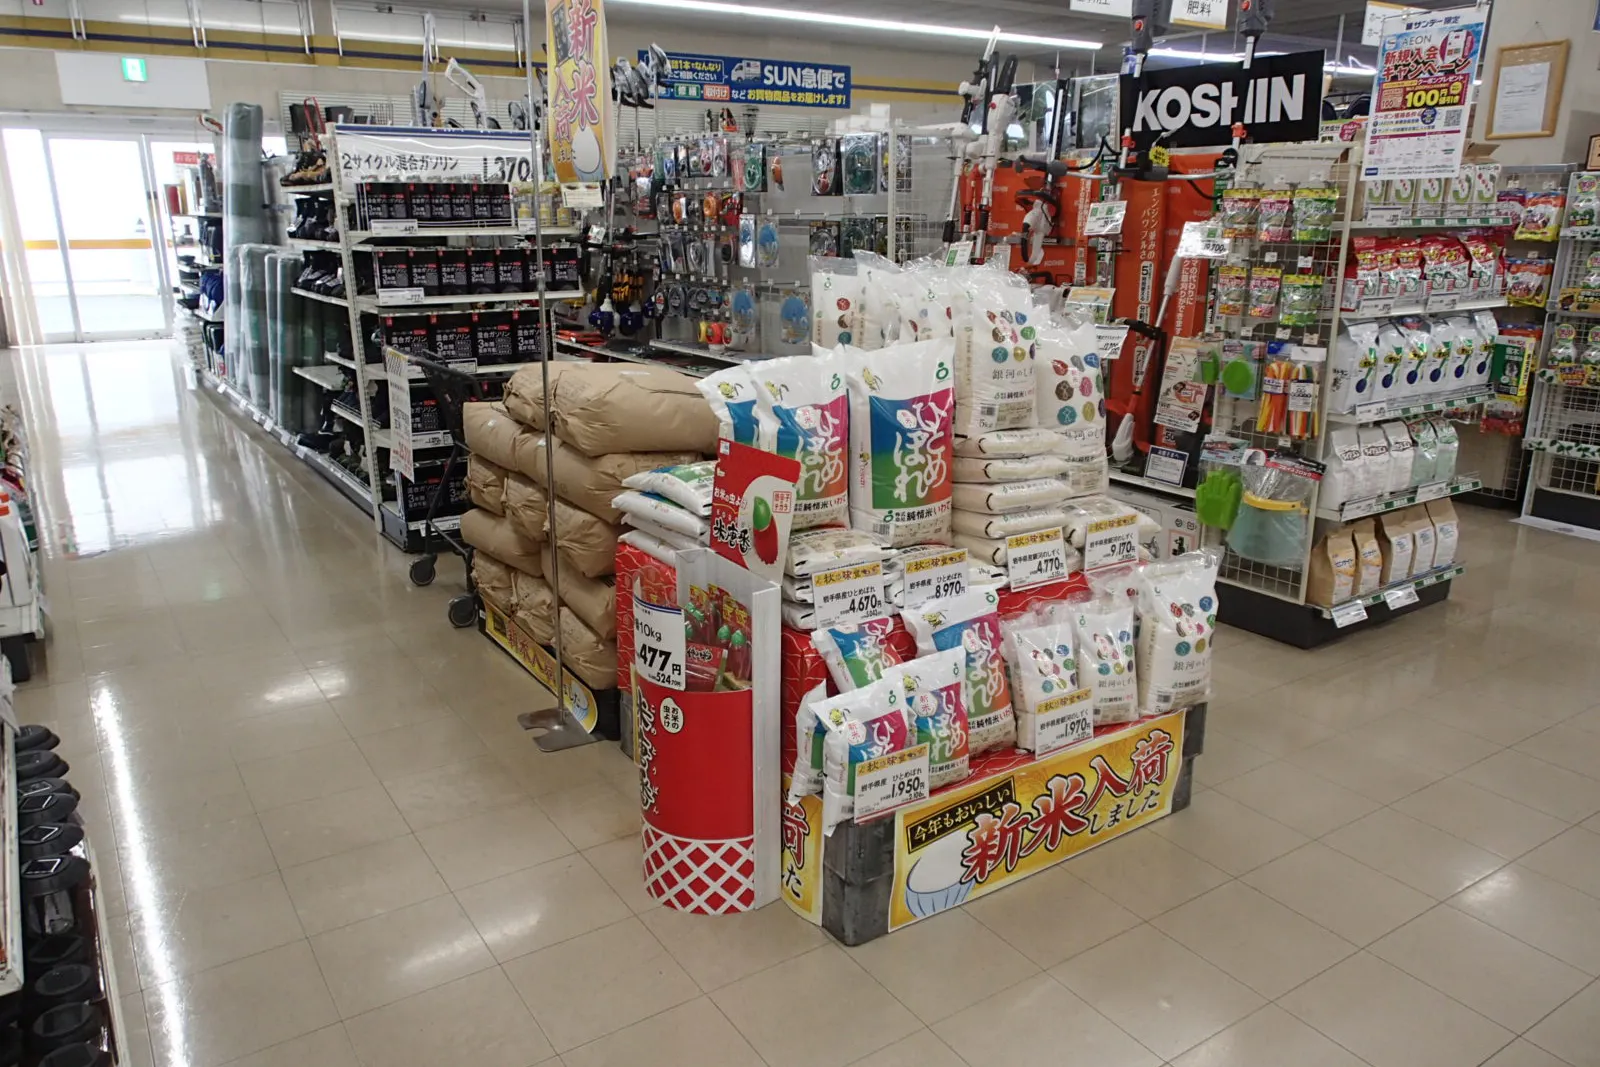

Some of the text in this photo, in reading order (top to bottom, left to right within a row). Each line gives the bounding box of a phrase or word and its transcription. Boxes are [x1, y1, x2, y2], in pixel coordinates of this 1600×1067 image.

[1187, 1, 1211, 16] 肥料
[1132, 73, 1305, 132] KOSHIN
[341, 153, 459, 172] 2サイクル混合ガソリン
[671, 706, 680, 730] お米の
[913, 787, 1012, 841] 今年もおいしい
[960, 729, 1174, 884] 新米入荷
[1089, 790, 1160, 837] しました
